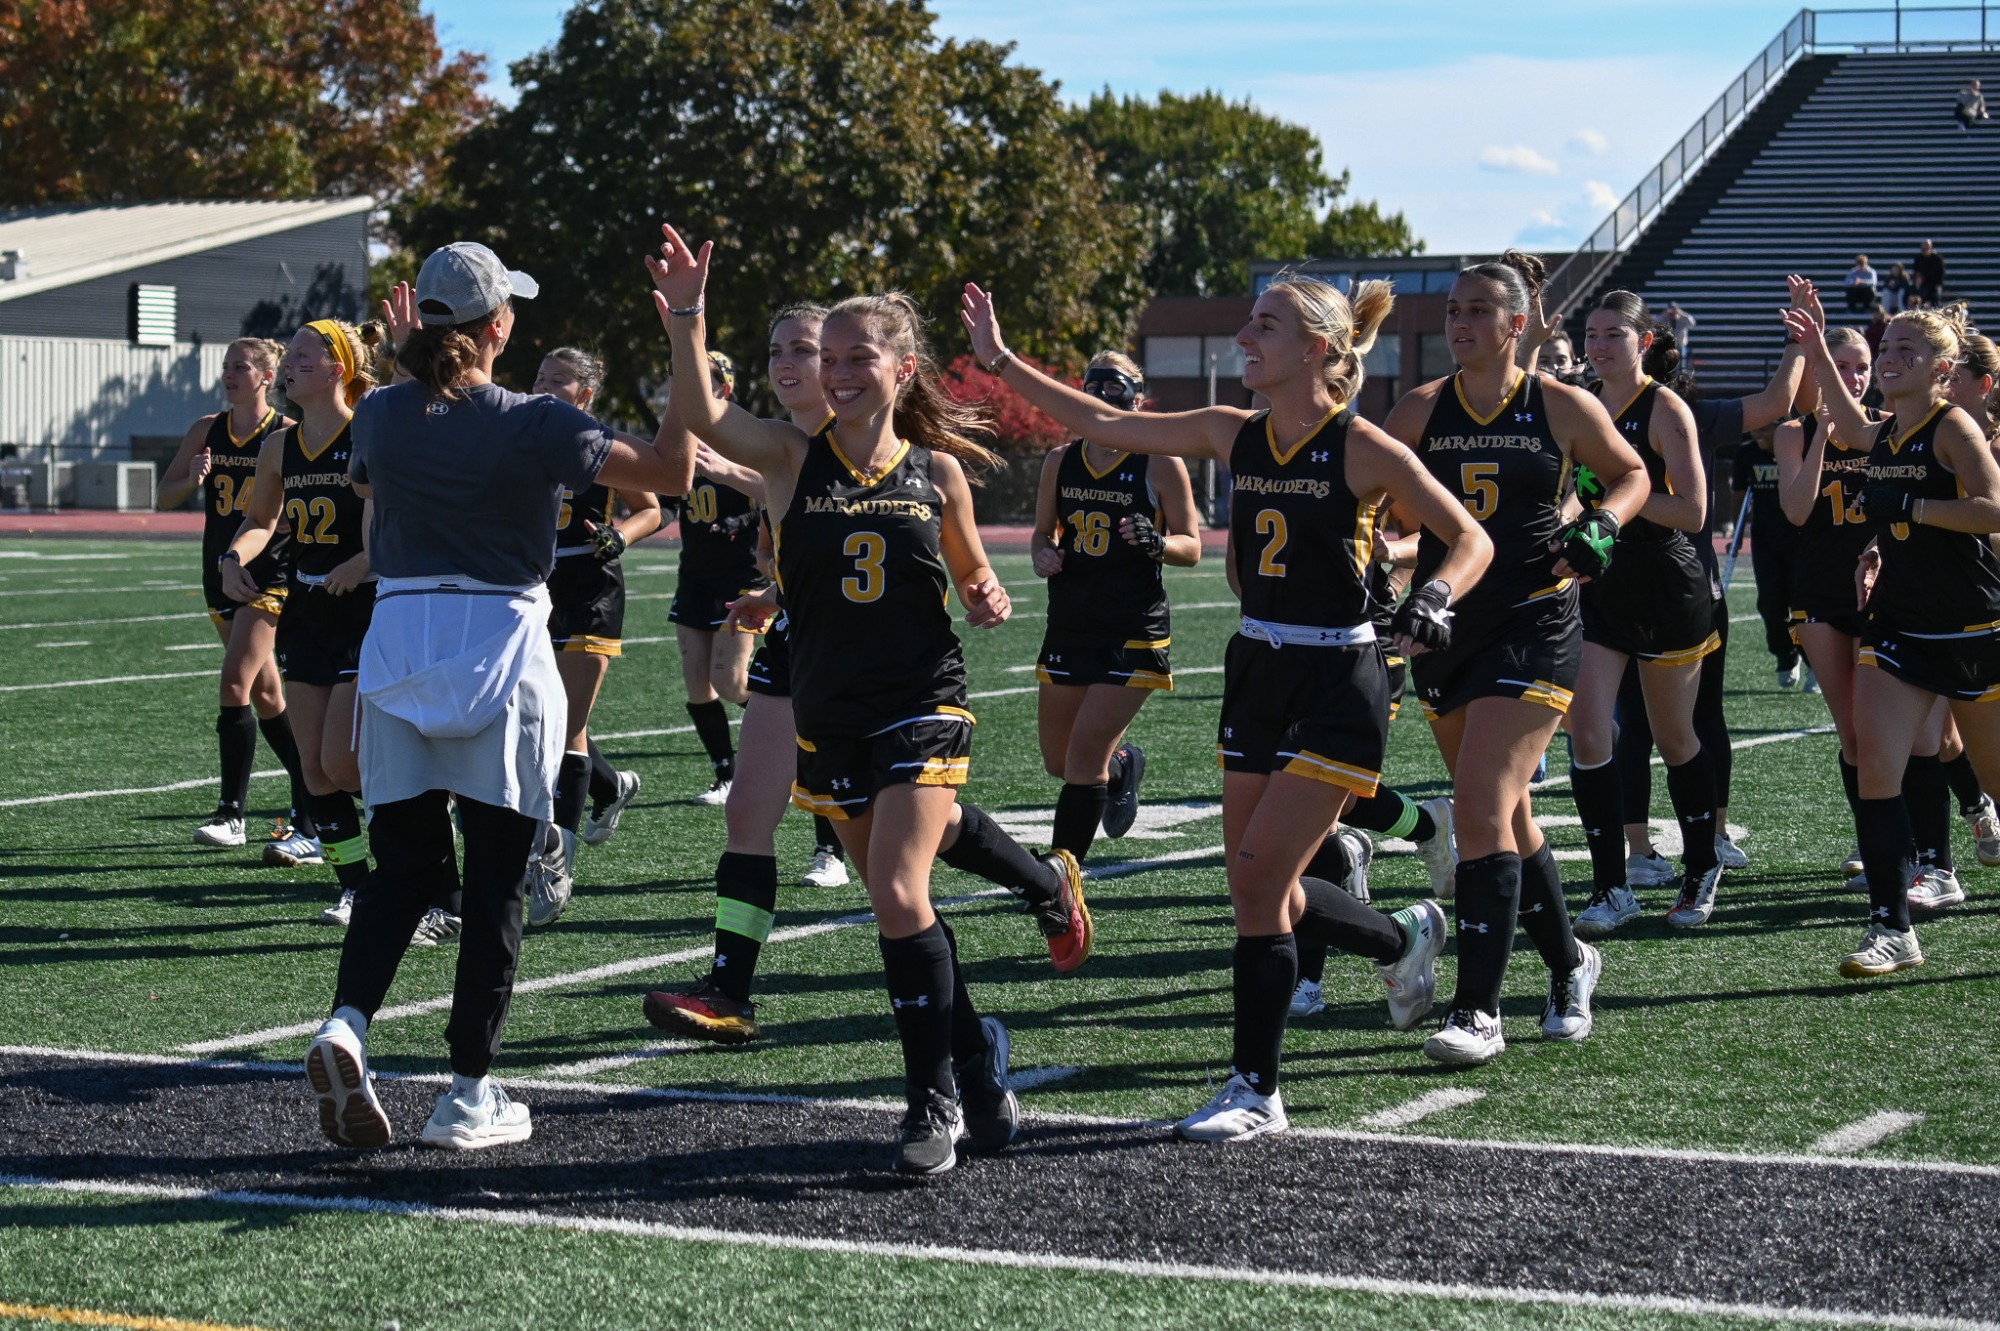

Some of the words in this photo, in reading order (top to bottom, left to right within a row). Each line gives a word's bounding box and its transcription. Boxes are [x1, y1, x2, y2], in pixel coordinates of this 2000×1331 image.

[1428, 435, 1542, 453] MARAUDERS
[214, 474, 256, 517] 34
[284, 472, 351, 489] MARAUDERS
[1061, 486, 1133, 506] MARAUDERS
[1234, 474, 1330, 499] MARAUDERS
[1461, 462, 1499, 521] 5
[286, 496, 339, 544] 22
[682, 484, 717, 523] 30
[804, 496, 932, 521] MARAUDERS
[1067, 509, 1110, 556] 16
[1256, 508, 1287, 577] 2
[842, 531, 886, 603] 3
